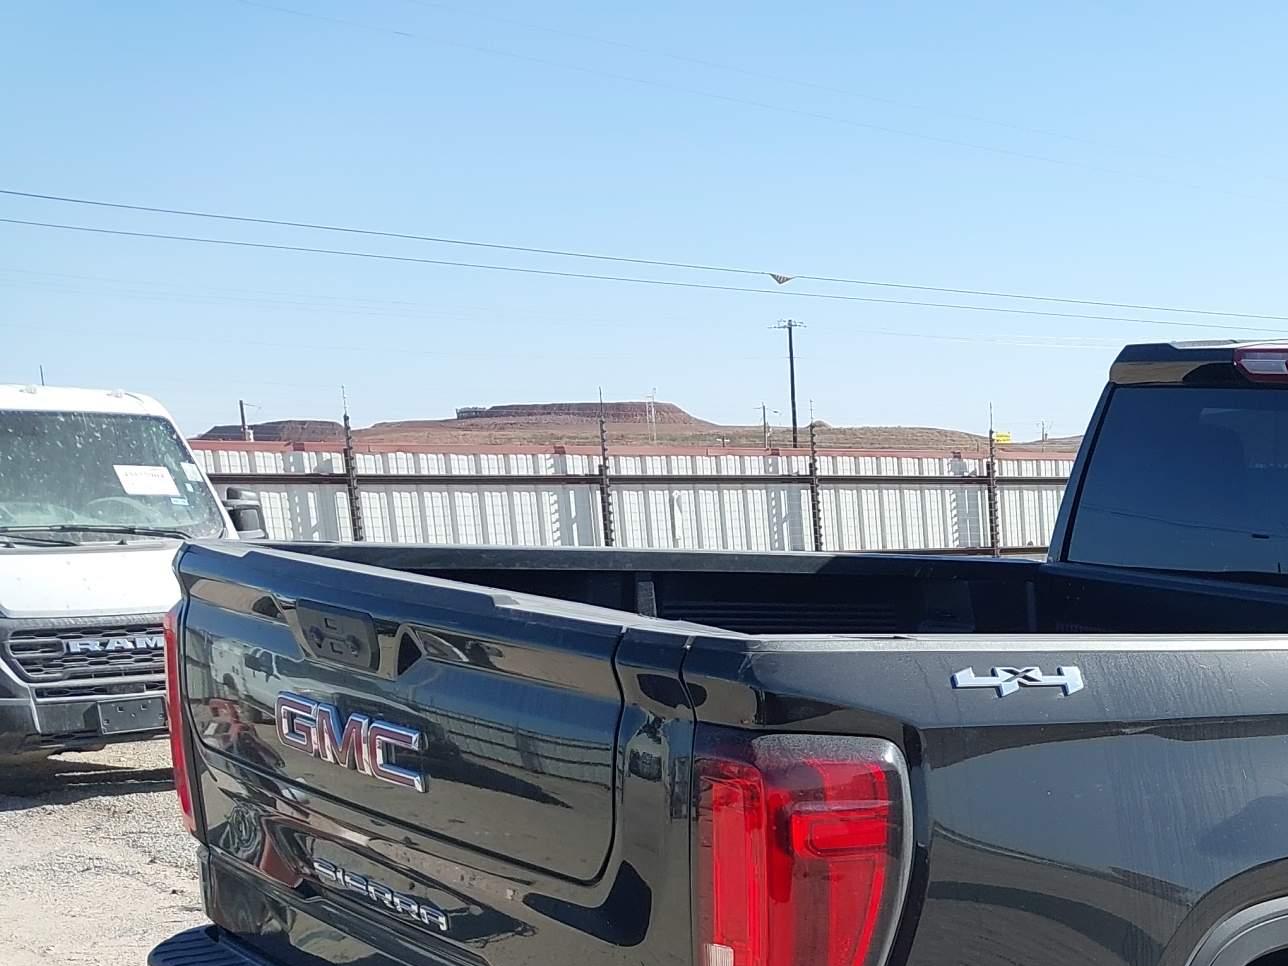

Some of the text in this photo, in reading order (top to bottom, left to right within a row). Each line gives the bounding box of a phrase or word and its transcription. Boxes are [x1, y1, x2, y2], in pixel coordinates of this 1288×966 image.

[66, 635, 165, 653] RAM
[275, 689, 430, 794] GMC
[313, 857, 450, 932] SIERRA
